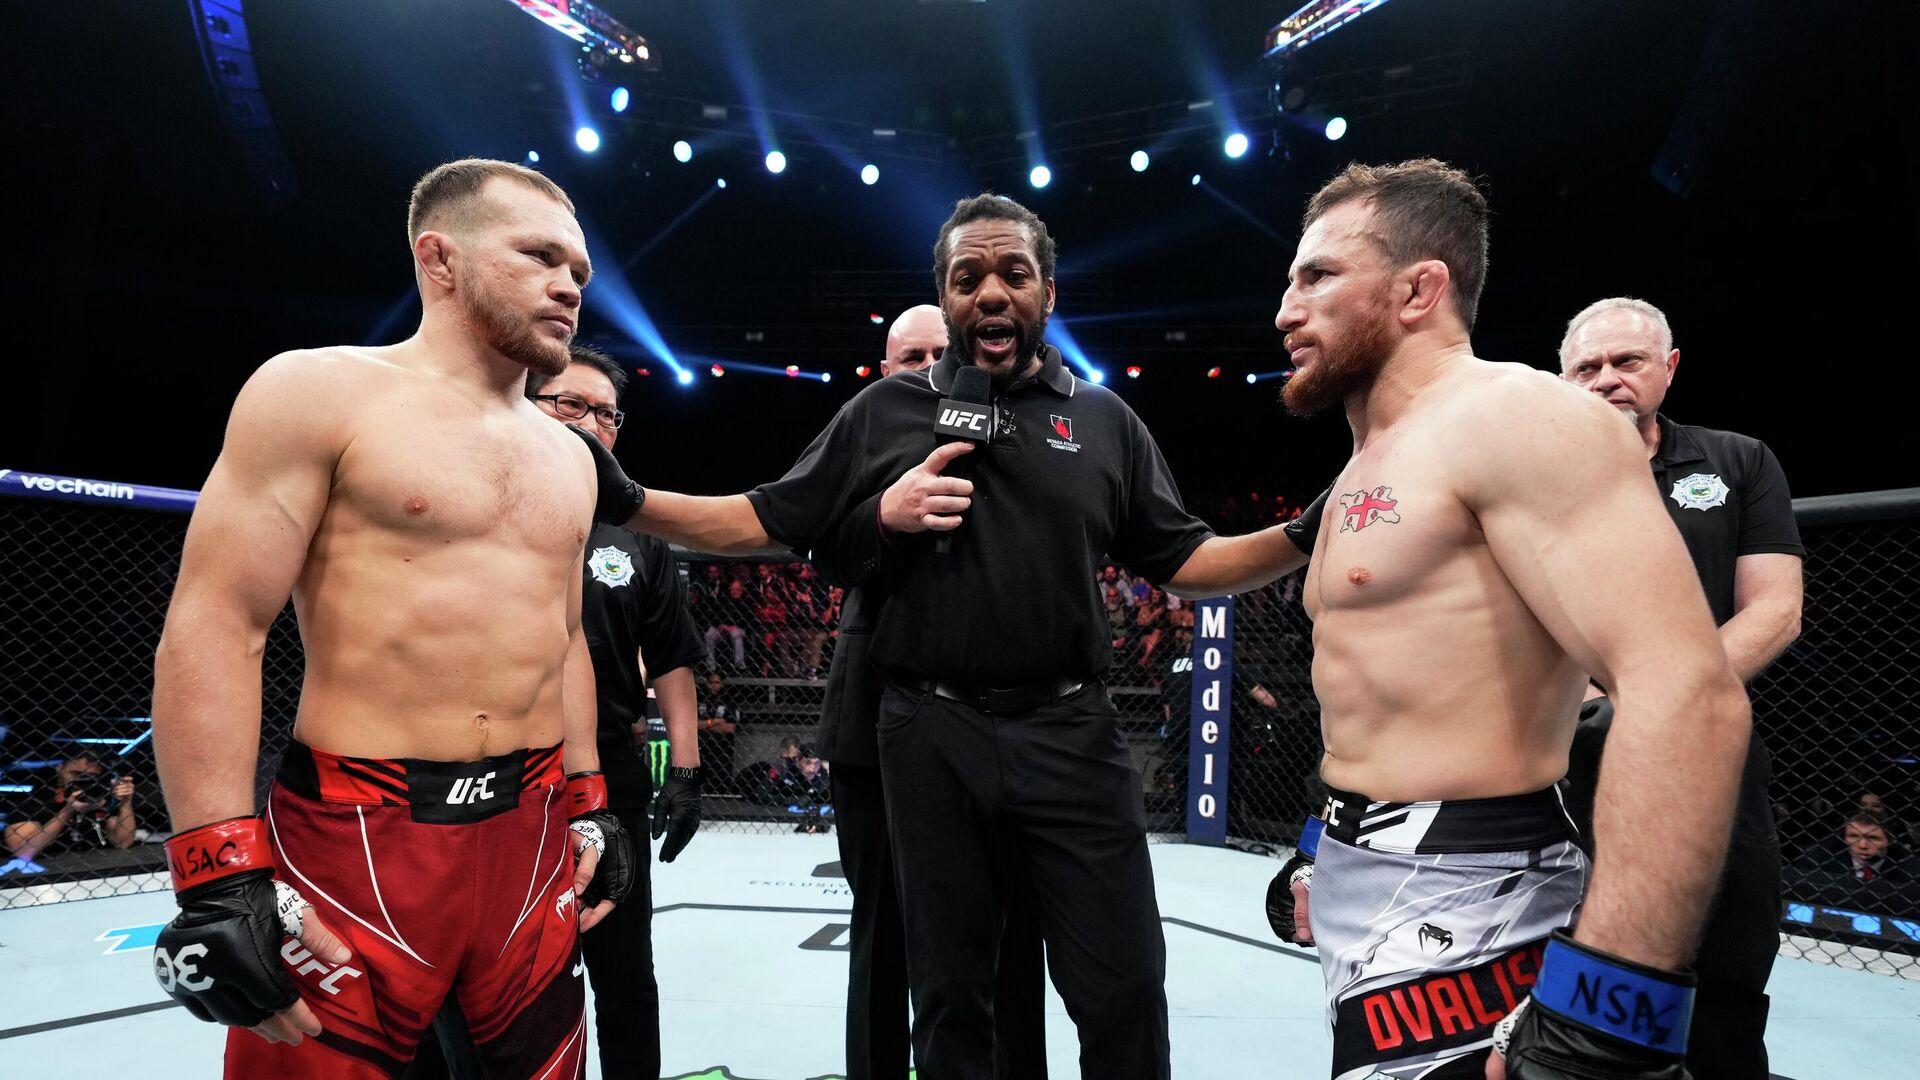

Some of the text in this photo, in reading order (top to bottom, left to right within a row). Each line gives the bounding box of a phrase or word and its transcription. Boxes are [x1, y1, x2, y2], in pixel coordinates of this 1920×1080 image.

[939, 408, 987, 431] UFC
[20, 474, 135, 500] vechain
[1198, 606, 1227, 818] Modelo
[446, 771, 496, 805] UFC
[280, 893, 300, 915] UFC
